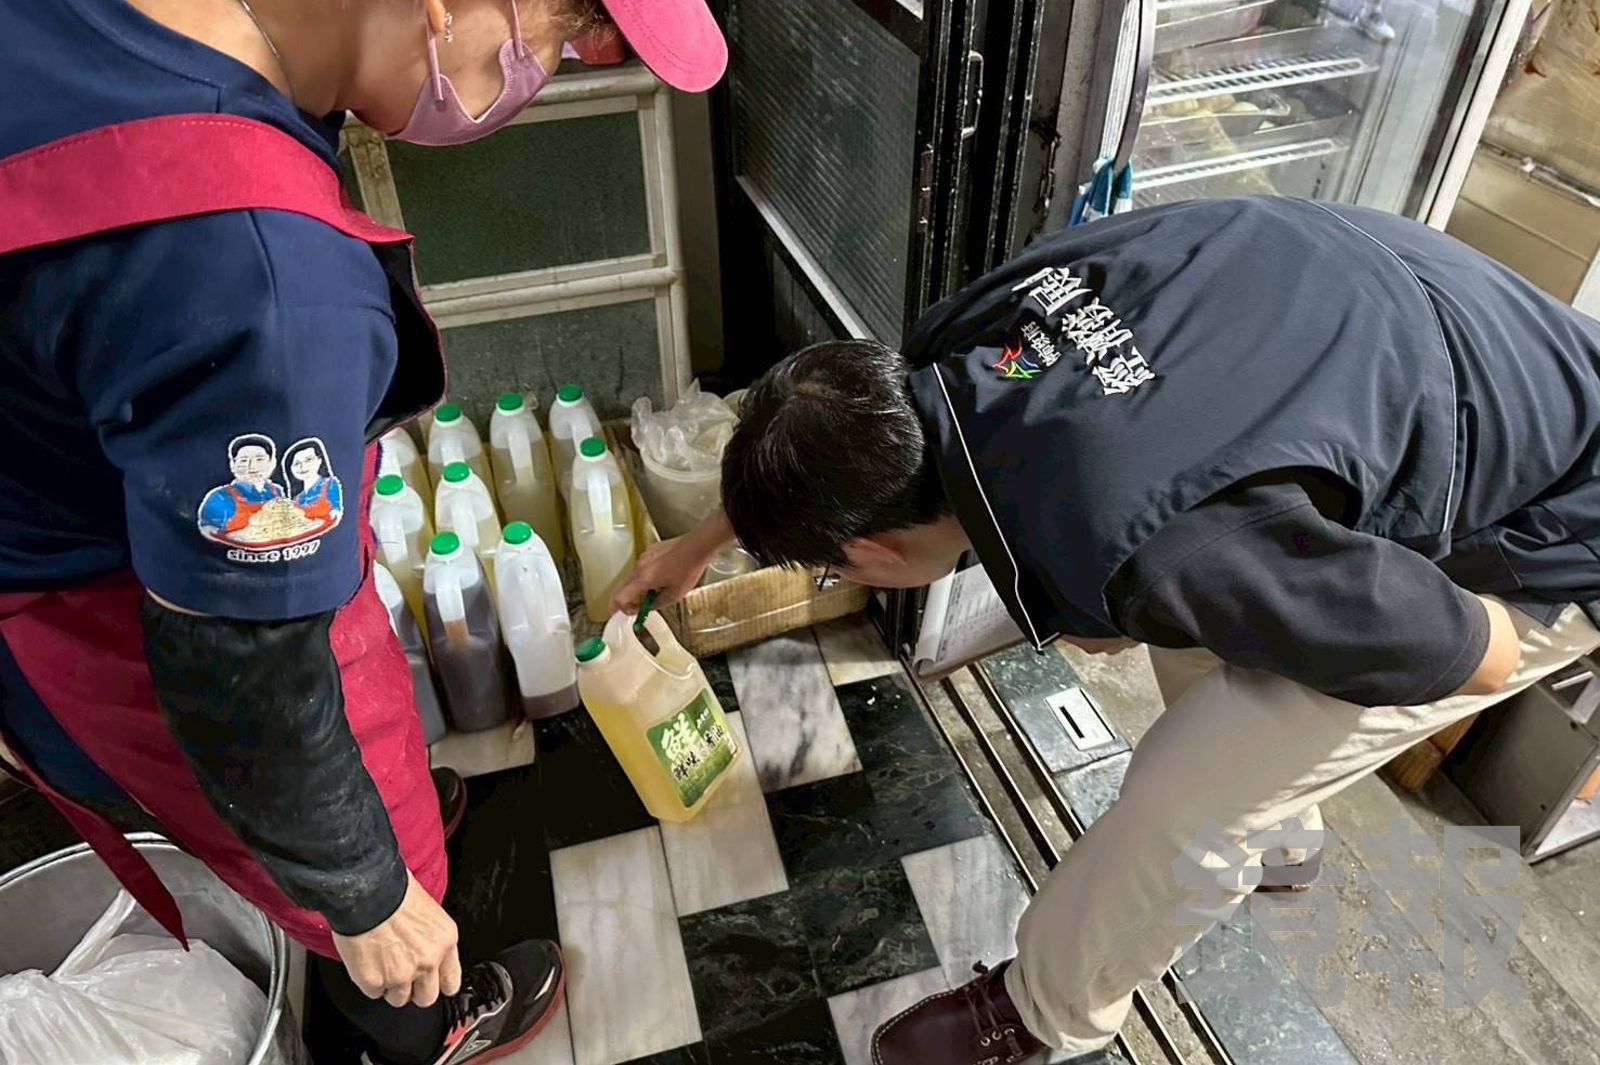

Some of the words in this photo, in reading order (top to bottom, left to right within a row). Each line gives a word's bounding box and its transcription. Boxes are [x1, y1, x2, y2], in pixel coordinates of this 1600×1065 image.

[1011, 267, 1156, 396] 經濟發展
[227, 549, 281, 562] since
[282, 539, 321, 561] 1997
